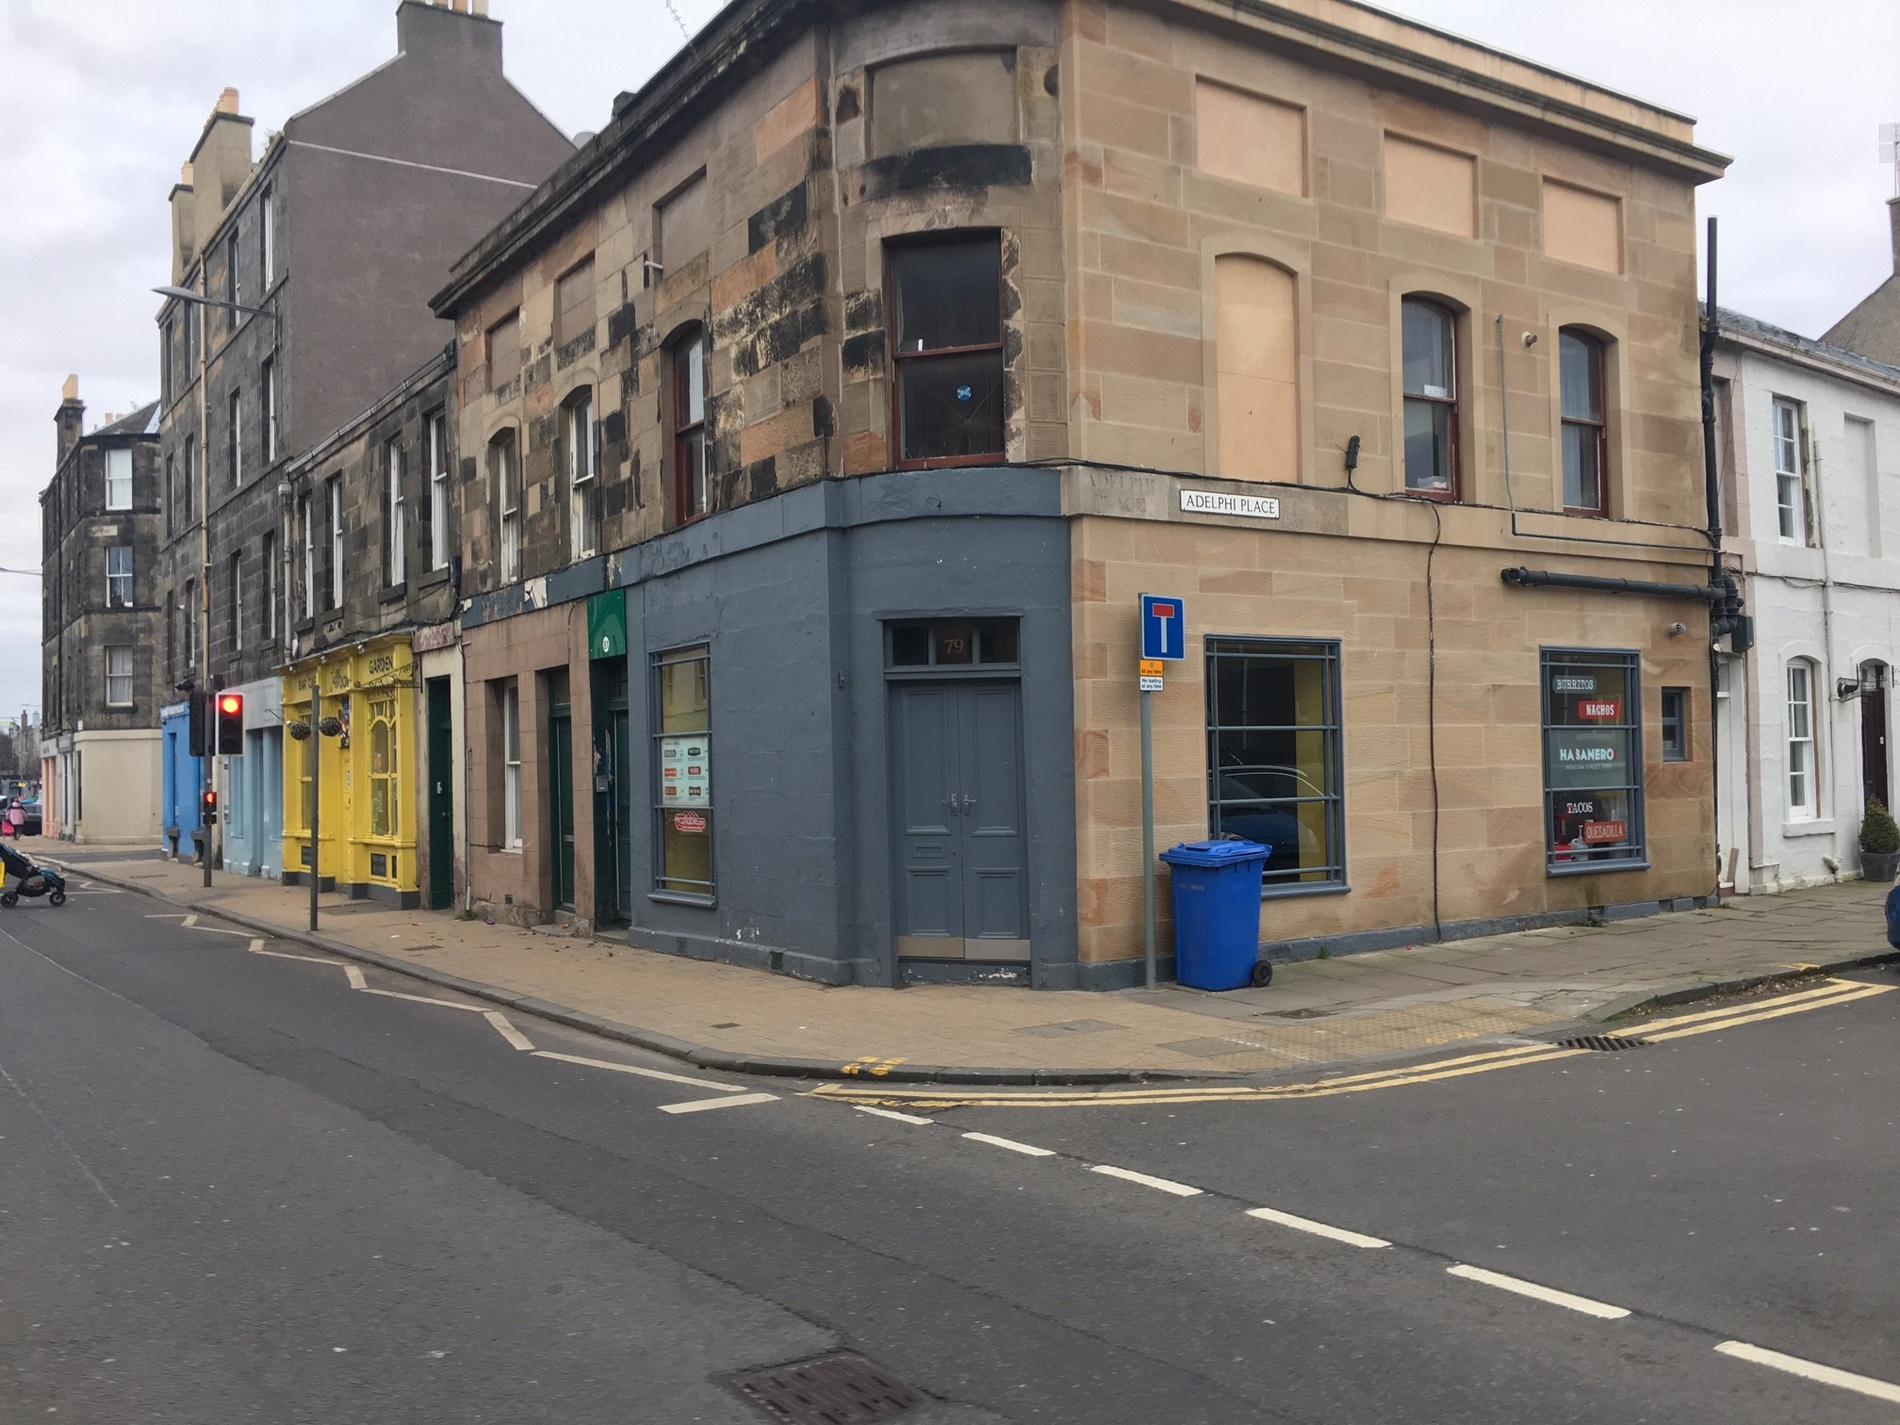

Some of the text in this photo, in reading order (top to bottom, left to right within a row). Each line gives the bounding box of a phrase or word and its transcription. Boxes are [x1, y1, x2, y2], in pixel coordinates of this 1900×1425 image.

[1186, 495, 1275, 514] ADELPHI PLACE
[944, 639, 965, 655] 79
[368, 656, 394, 675] GARDEN
[1556, 679, 1594, 690] BURRITOS
[1586, 704, 1615, 716] NACHOS
[1560, 748, 1615, 761] HABANERO
[1567, 802, 1593, 814] TACOS
[1586, 824, 1623, 839] QUESADILLA
